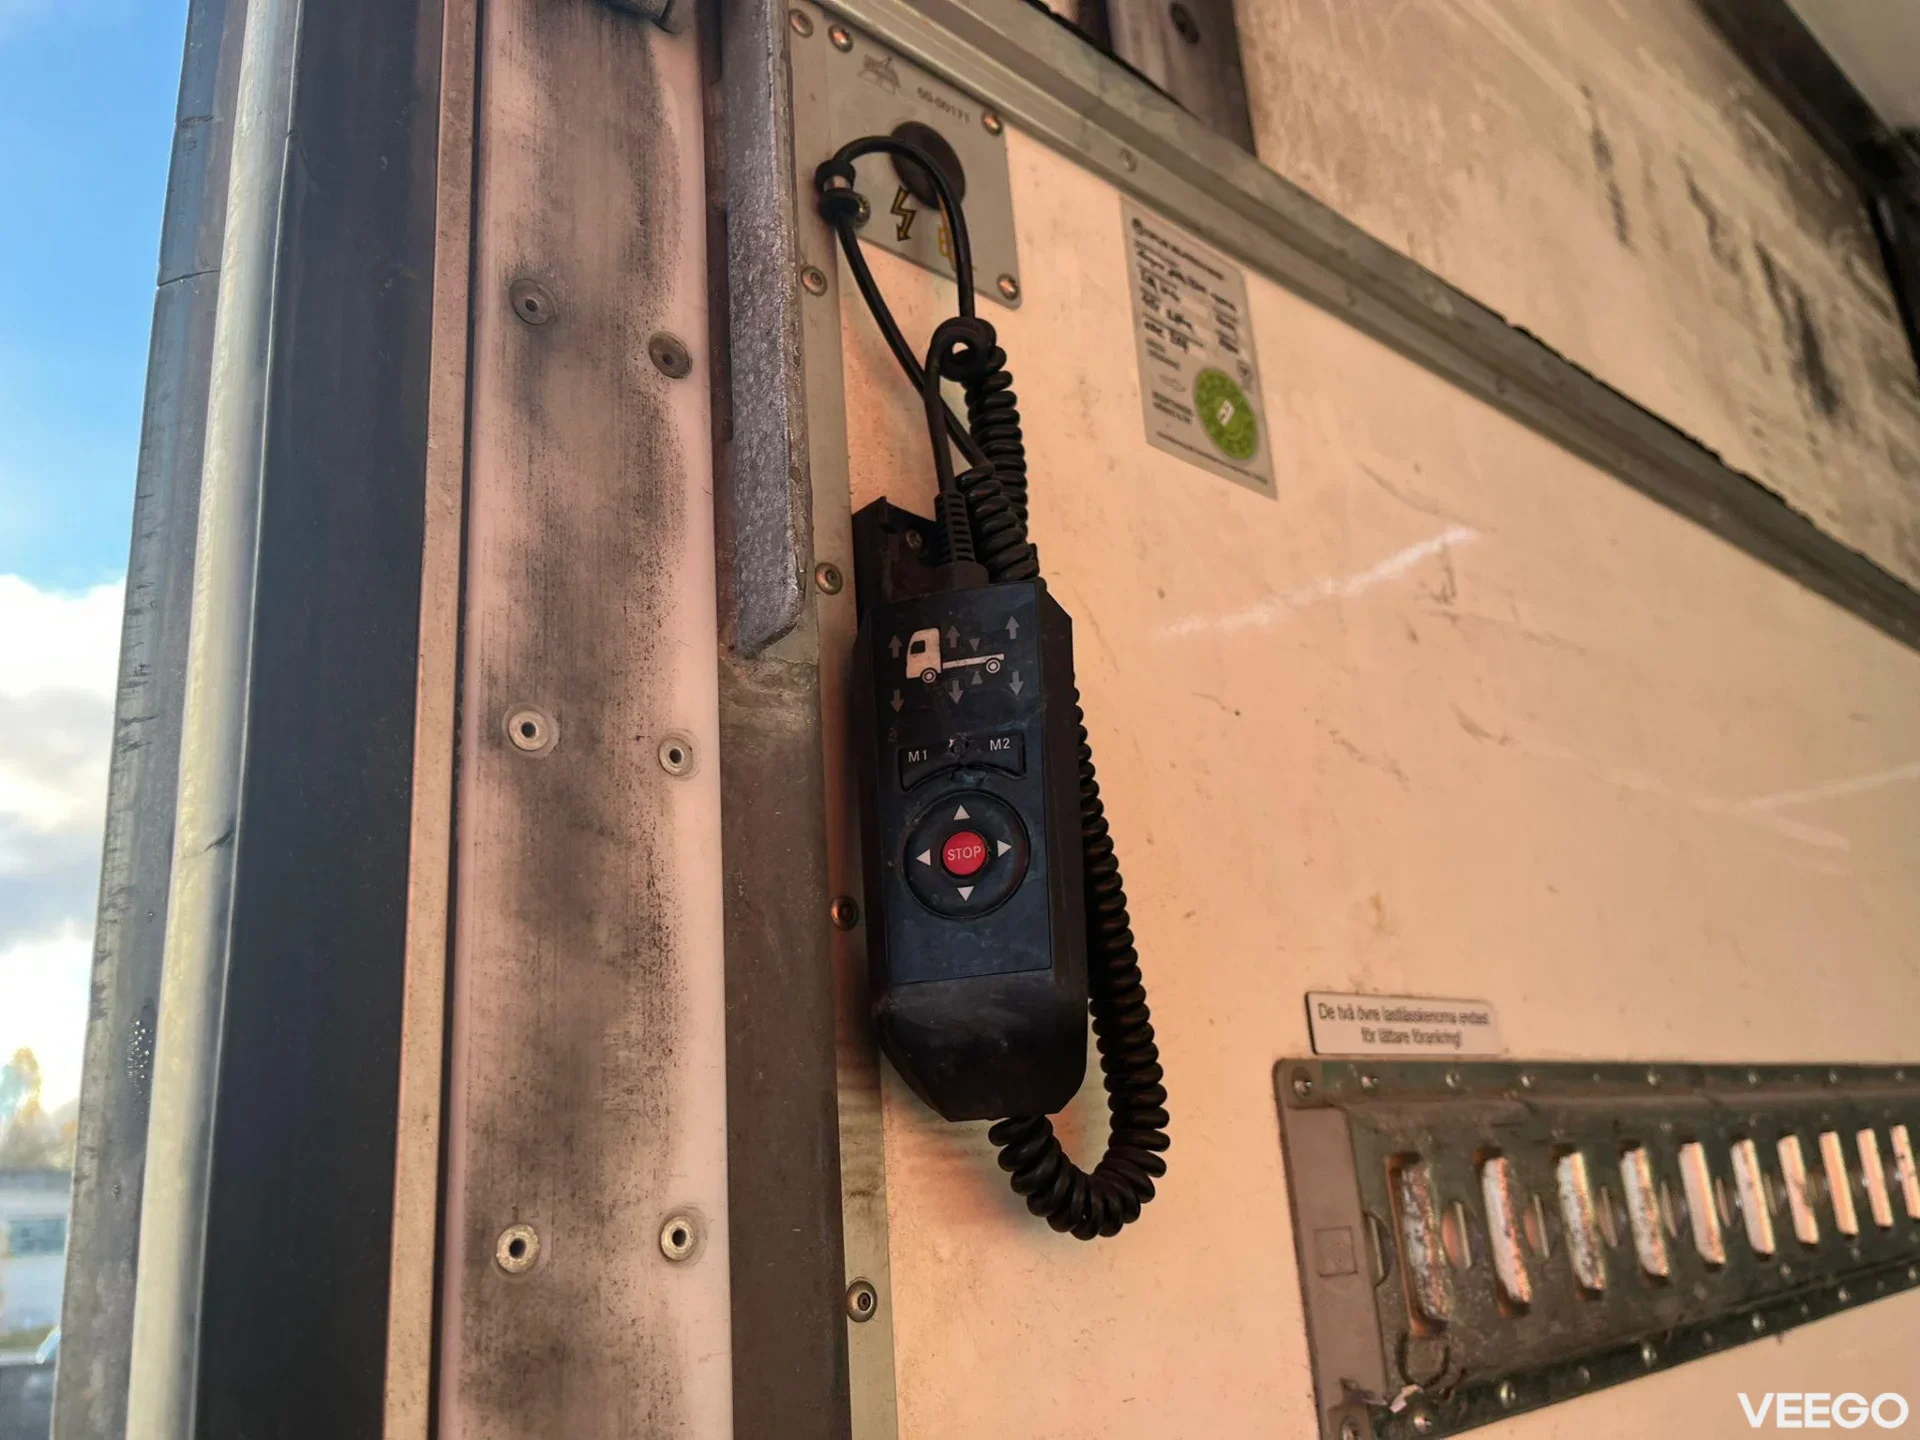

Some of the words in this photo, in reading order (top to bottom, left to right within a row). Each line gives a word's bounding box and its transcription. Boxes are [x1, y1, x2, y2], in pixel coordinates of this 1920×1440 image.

[989, 737, 1011, 751] M2
[908, 750, 928, 763] M1
[947, 845, 981, 860] STOP
[1318, 1002, 1335, 1020] De
[1337, 1003, 1355, 1021] två
[1356, 1004, 1381, 1021] övre
[1361, 1027, 1376, 1044] för
